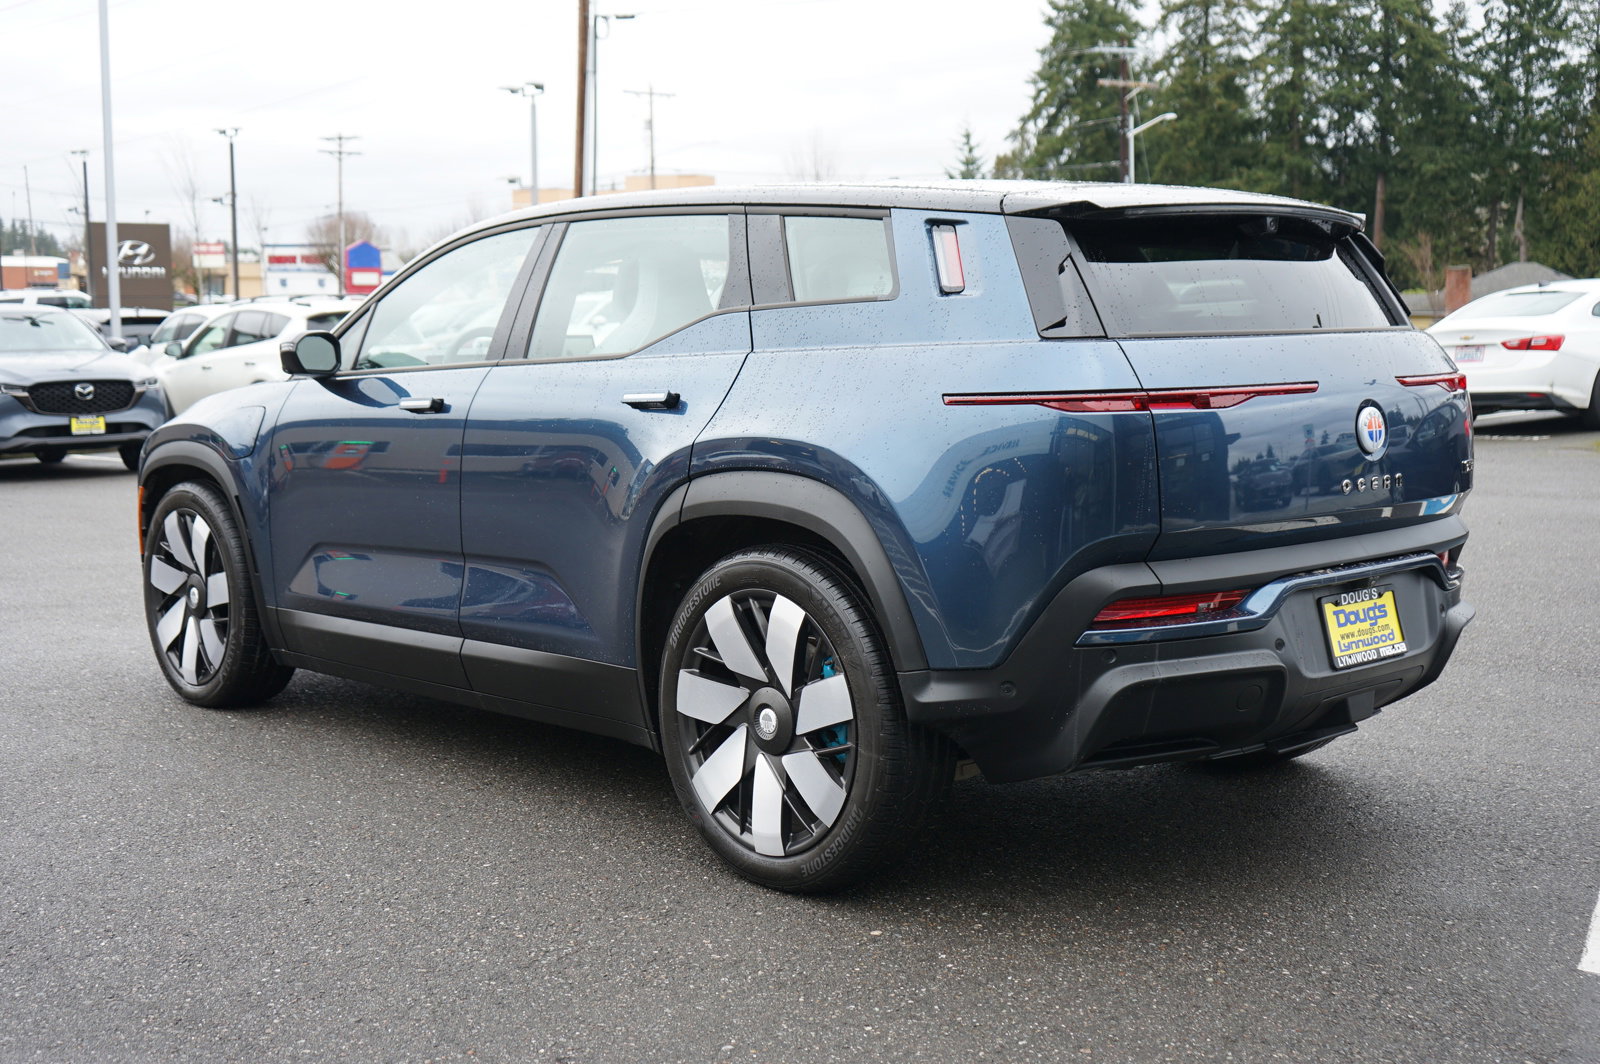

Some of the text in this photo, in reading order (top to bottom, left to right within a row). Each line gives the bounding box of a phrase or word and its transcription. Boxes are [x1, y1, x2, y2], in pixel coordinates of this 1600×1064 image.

[102, 265, 166, 278] HUNDAI
[1341, 472, 1404, 495] OCEAN
[1341, 588, 1378, 605] DOUG'S
[669, 576, 722, 649] BRIDGESTONE
[1333, 602, 1388, 627] Doug's
[1338, 628, 1395, 653] Lynnwood
[1340, 624, 1390, 640] www.dougs.com
[1338, 650, 1378, 667] LYNNWOOD
[800, 803, 863, 877] BRIDGESTONE
